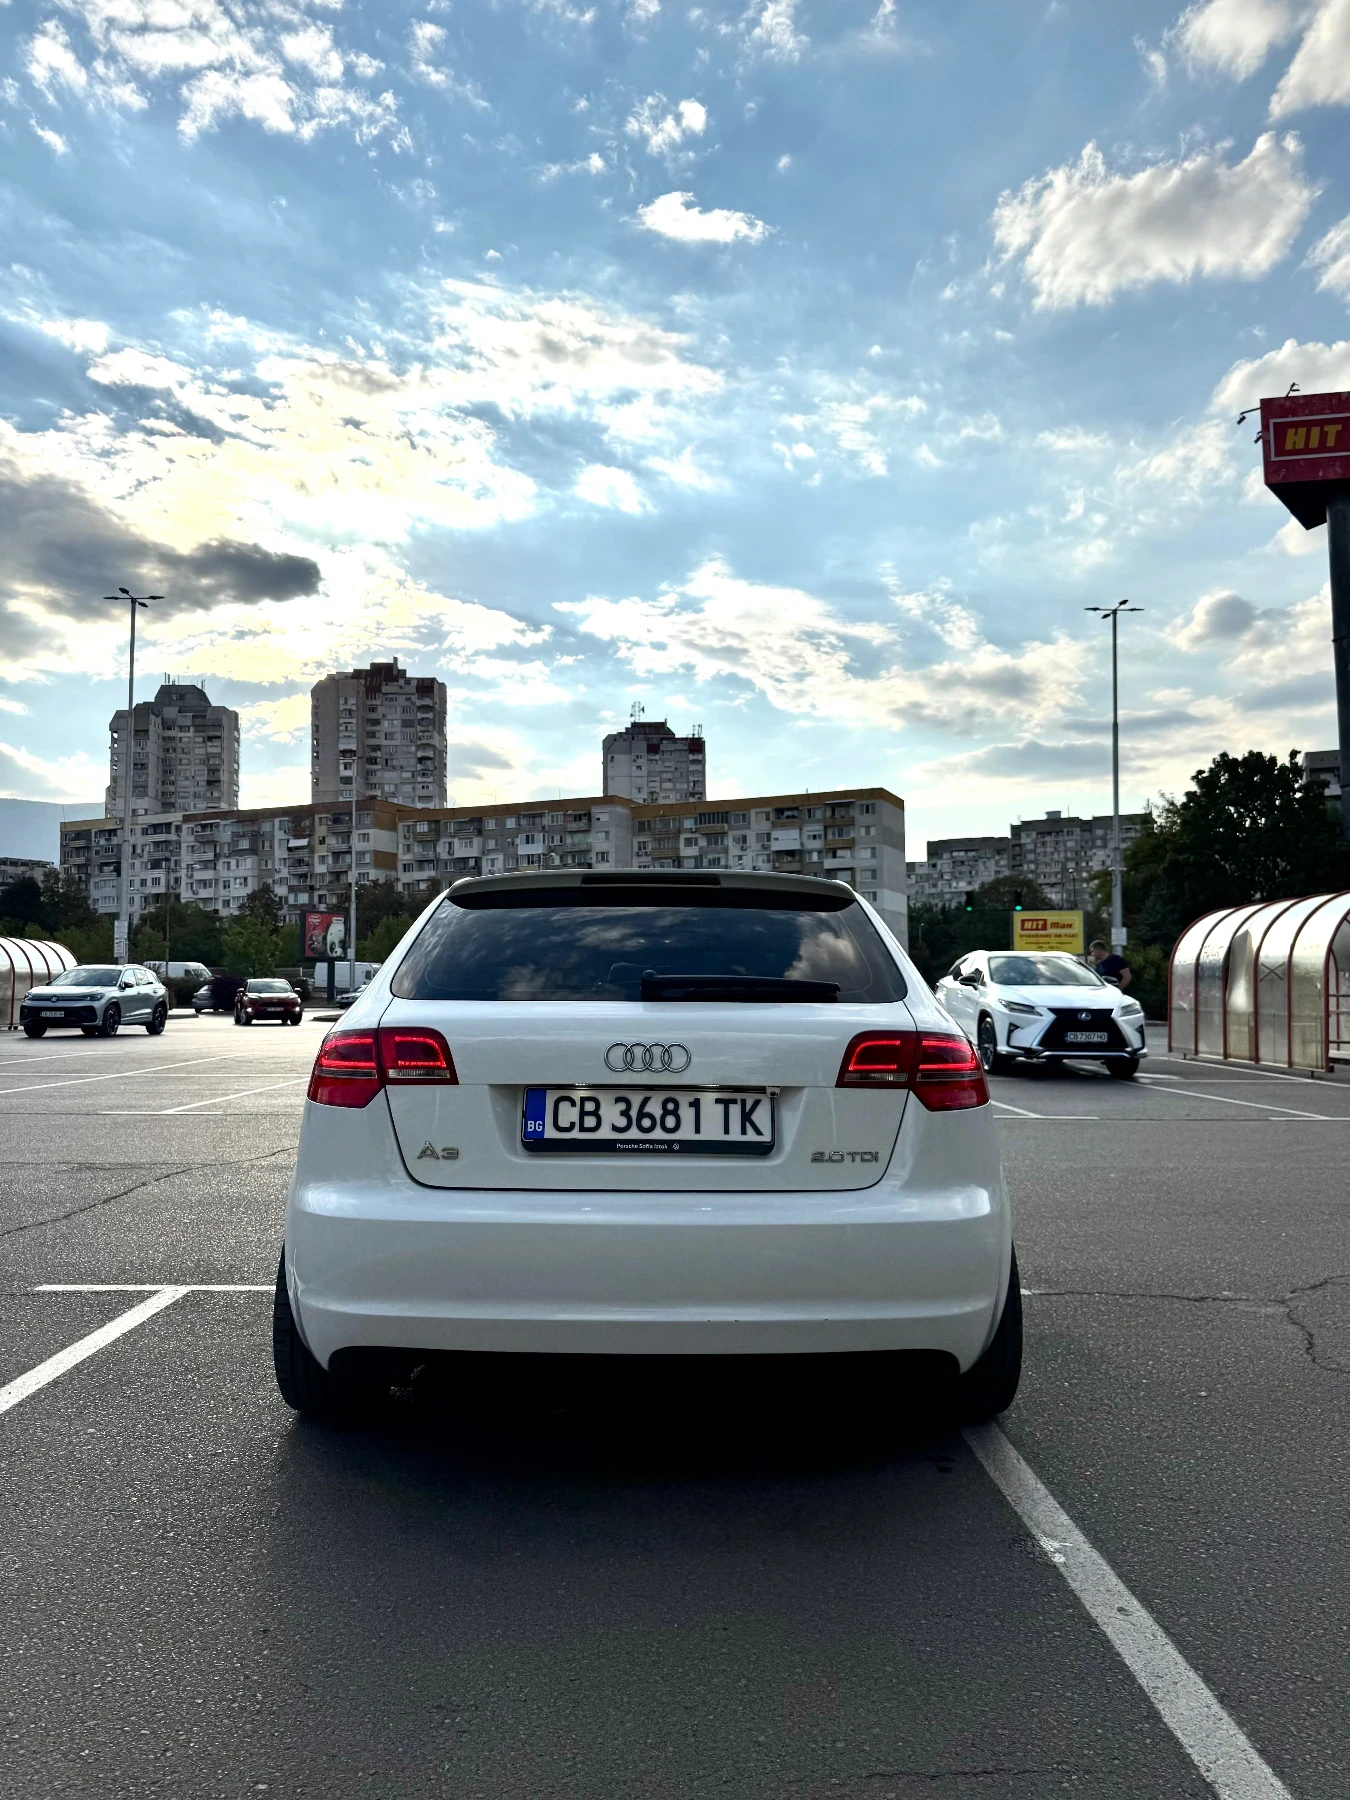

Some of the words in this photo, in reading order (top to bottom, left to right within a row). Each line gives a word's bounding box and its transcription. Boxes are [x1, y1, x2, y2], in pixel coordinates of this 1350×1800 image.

[1284, 424, 1343, 450] HIT
[1023, 920, 1044, 929] HIT
[552, 1095, 602, 1133] CB
[611, 1096, 702, 1135] 3681
[714, 1097, 765, 1136] TK
[527, 1120, 543, 1132] BG
[416, 1140, 459, 1160] A3
[810, 1150, 845, 1163] 2.0
[846, 1150, 879, 1163] TDI
